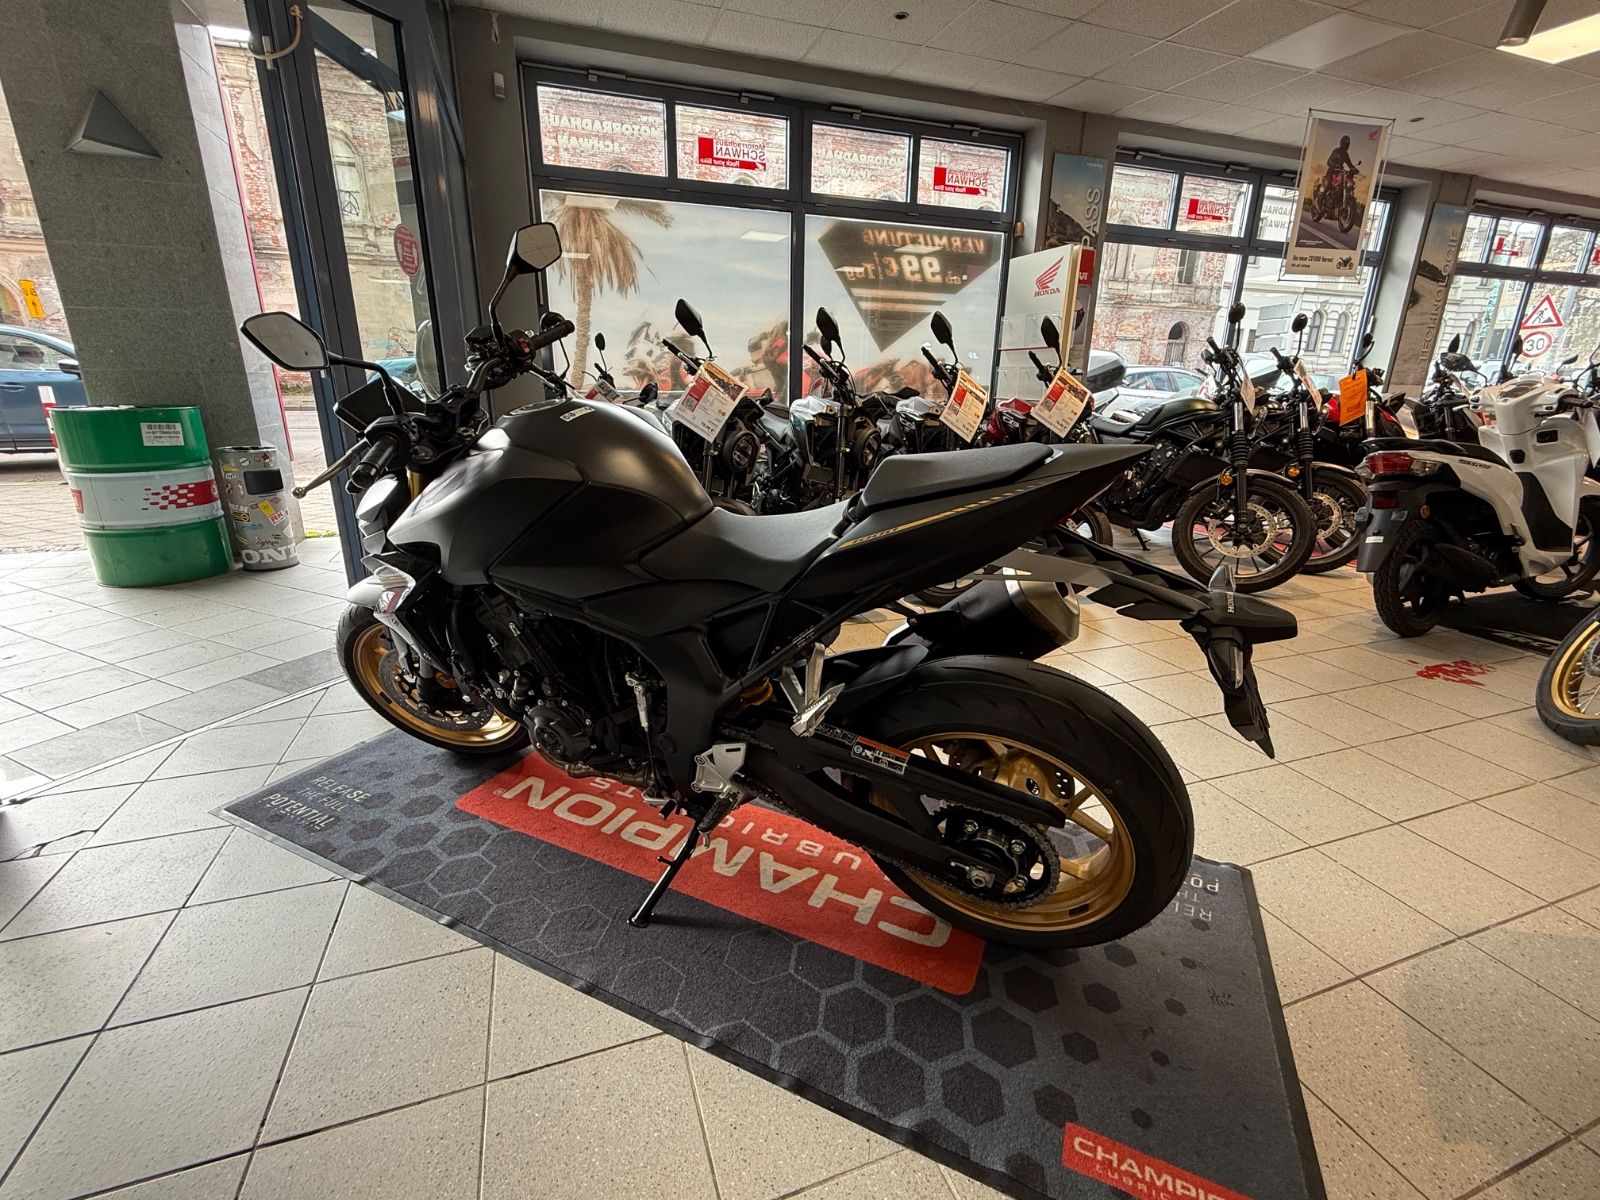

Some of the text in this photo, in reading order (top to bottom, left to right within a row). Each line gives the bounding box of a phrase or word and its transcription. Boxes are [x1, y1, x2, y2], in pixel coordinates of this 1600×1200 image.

[1034, 288, 1060, 297] HONDA
[1418, 228, 1459, 363] TECHNOLOGIE
[1526, 338, 1545, 352] 30
[270, 511, 284, 522] RK
[297, 787, 350, 812] THE FULL
[310, 776, 371, 802] RELEASE
[262, 793, 335, 828] POTENTIAL
[500, 776, 952, 947] CHAMPION
